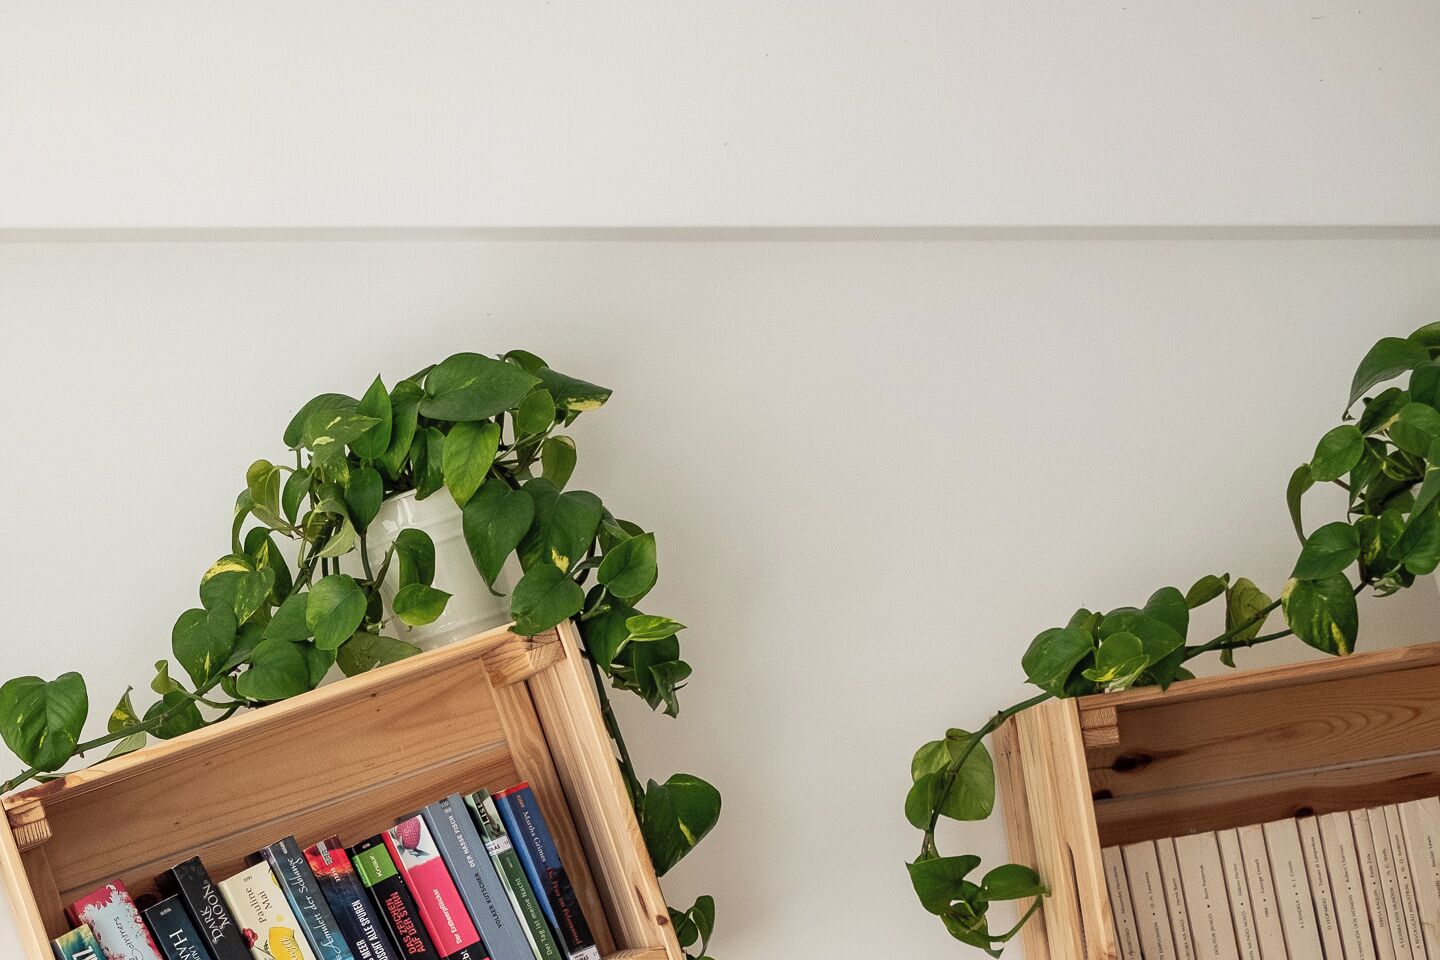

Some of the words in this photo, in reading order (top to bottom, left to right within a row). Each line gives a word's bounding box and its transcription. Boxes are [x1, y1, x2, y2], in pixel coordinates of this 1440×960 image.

[447, 814, 460, 833] FISCH
[455, 833, 469, 854] NASSE
[464, 853, 475, 868] DER
[473, 871, 492, 904] KUTSCHER
[514, 876, 528, 897] Nacht
[200, 882, 230, 928] MOON
[243, 885, 267, 924] Pauline
[255, 889, 273, 910] Mai
[390, 891, 408, 917] STIRN
[522, 897, 538, 920] meine
[351, 899, 370, 925] SPUREN
[385, 896, 408, 935] ZEICHEN
[487, 904, 502, 928] VOLKER
[199, 906, 223, 941] DARK
[362, 923, 378, 941] ALLE
[402, 917, 417, 935] DER
[532, 919, 542, 930] ist
[402, 934, 417, 954] DAS
[410, 934, 425, 953] AUF
[536, 929, 547, 942] Tag
[355, 938, 371, 958] MEER
[542, 942, 553, 956] Der
